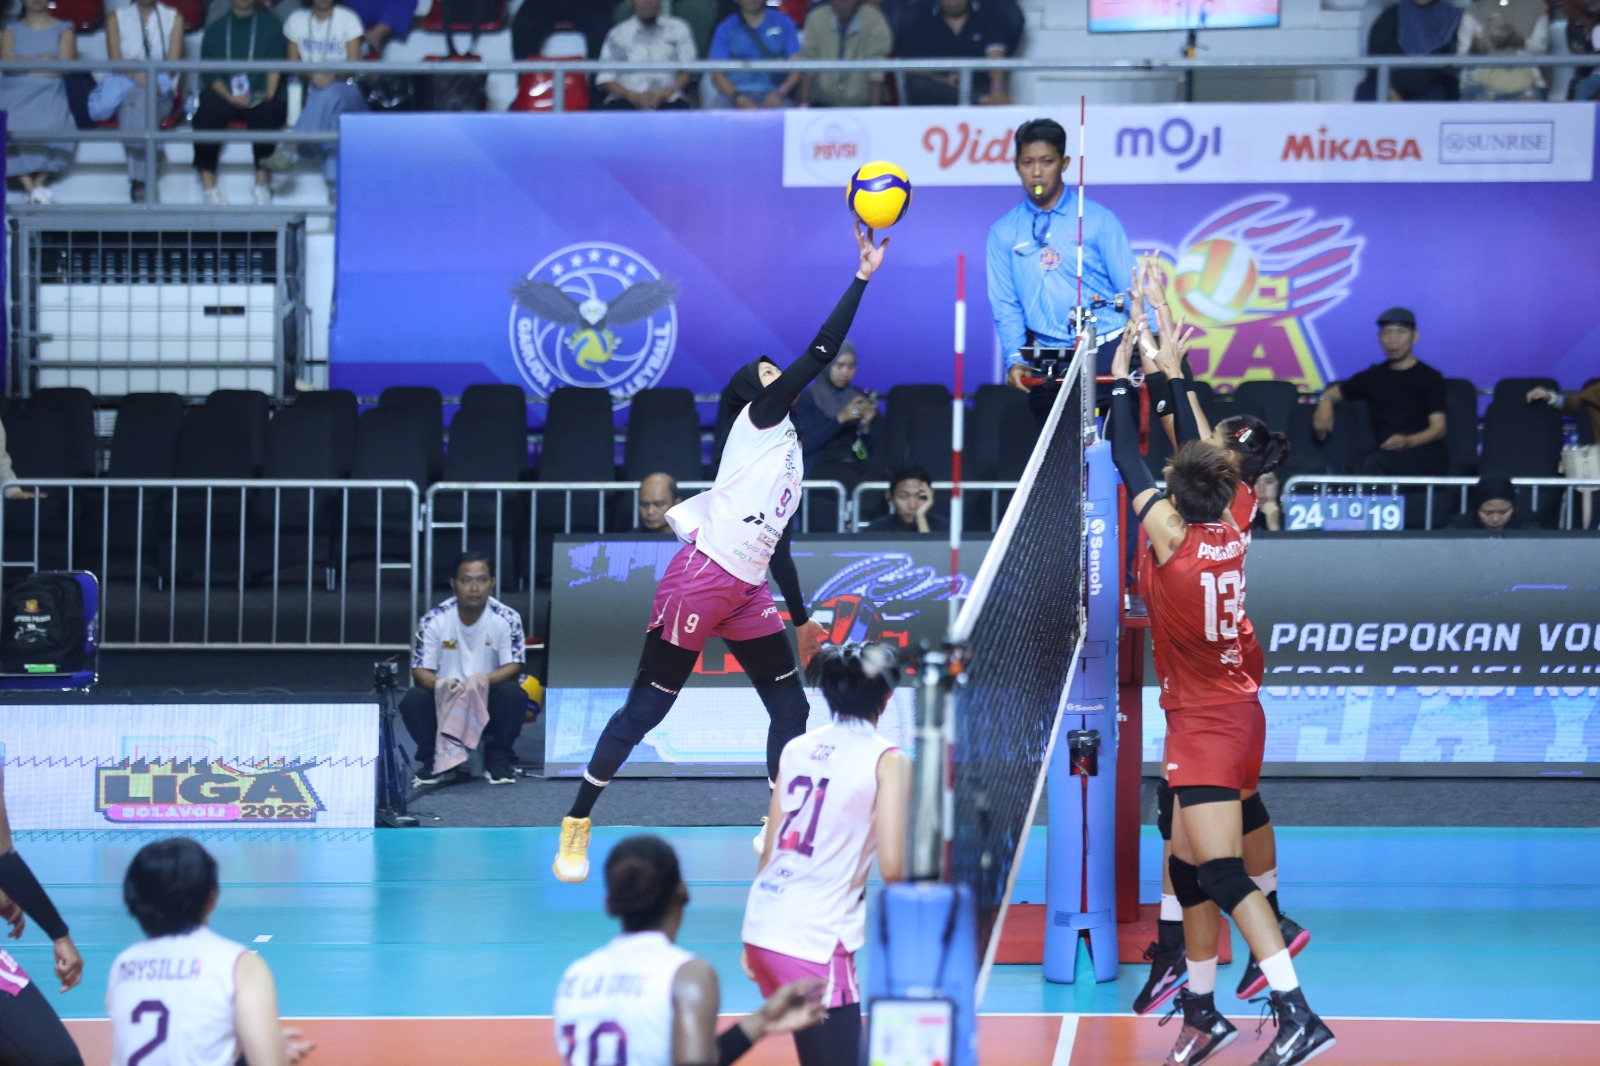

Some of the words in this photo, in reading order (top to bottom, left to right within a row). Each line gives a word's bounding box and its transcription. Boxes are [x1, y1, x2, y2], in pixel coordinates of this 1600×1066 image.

[922, 120, 1016, 169] Vid
[1465, 133, 1546, 151] SUNRISE
[775, 488, 792, 518] 9
[1289, 502, 1325, 530] 24
[1329, 502, 1339, 518] 1
[1348, 502, 1363, 518] 0
[1368, 504, 1400, 530] 19
[1090, 536, 1103, 596] Senoh
[1200, 570, 1241, 642] 13
[683, 613, 700, 634] 9
[1269, 622, 1521, 652] PADEPOKAN
[104, 773, 308, 805] LIGA
[241, 804, 312, 818] 2026
[778, 775, 830, 858] 21
[128, 1000, 170, 1066] 2
